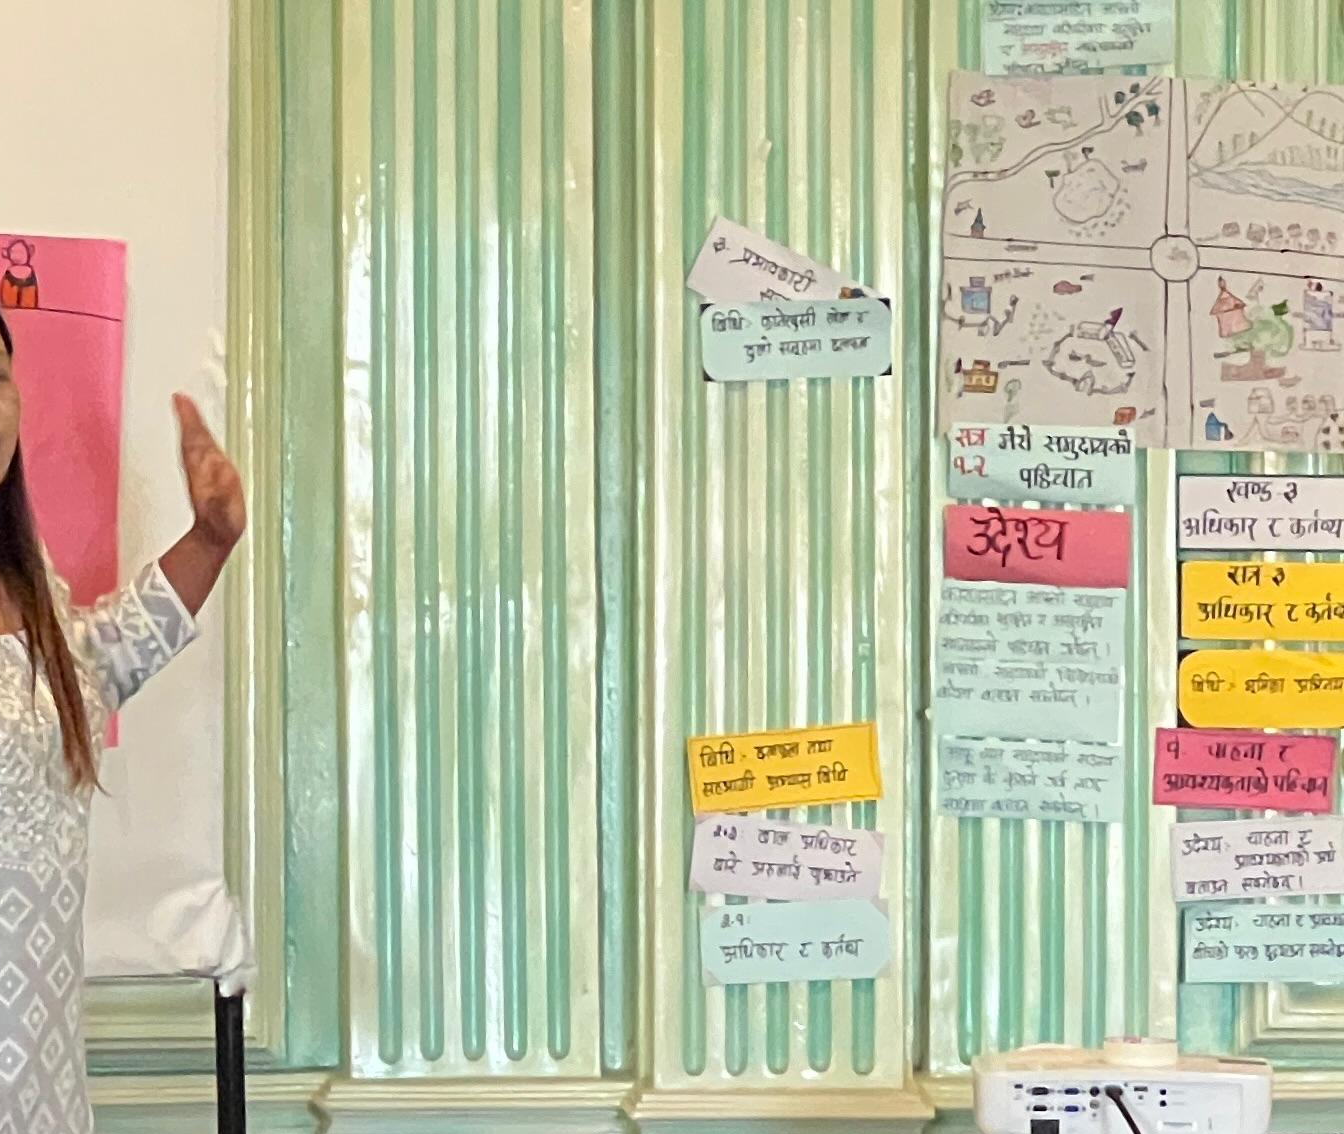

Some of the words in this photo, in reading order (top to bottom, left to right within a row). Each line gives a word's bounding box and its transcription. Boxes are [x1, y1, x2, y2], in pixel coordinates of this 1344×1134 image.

[1182, 508, 1259, 541] अधिकार
[1267, 517, 1284, 538] र
[1197, 595, 1276, 628] अधिकार
[1285, 603, 1303, 622] र
[1278, 744, 1296, 762] र
[1297, 829, 1313, 848] र
[798, 942, 812, 958] र
